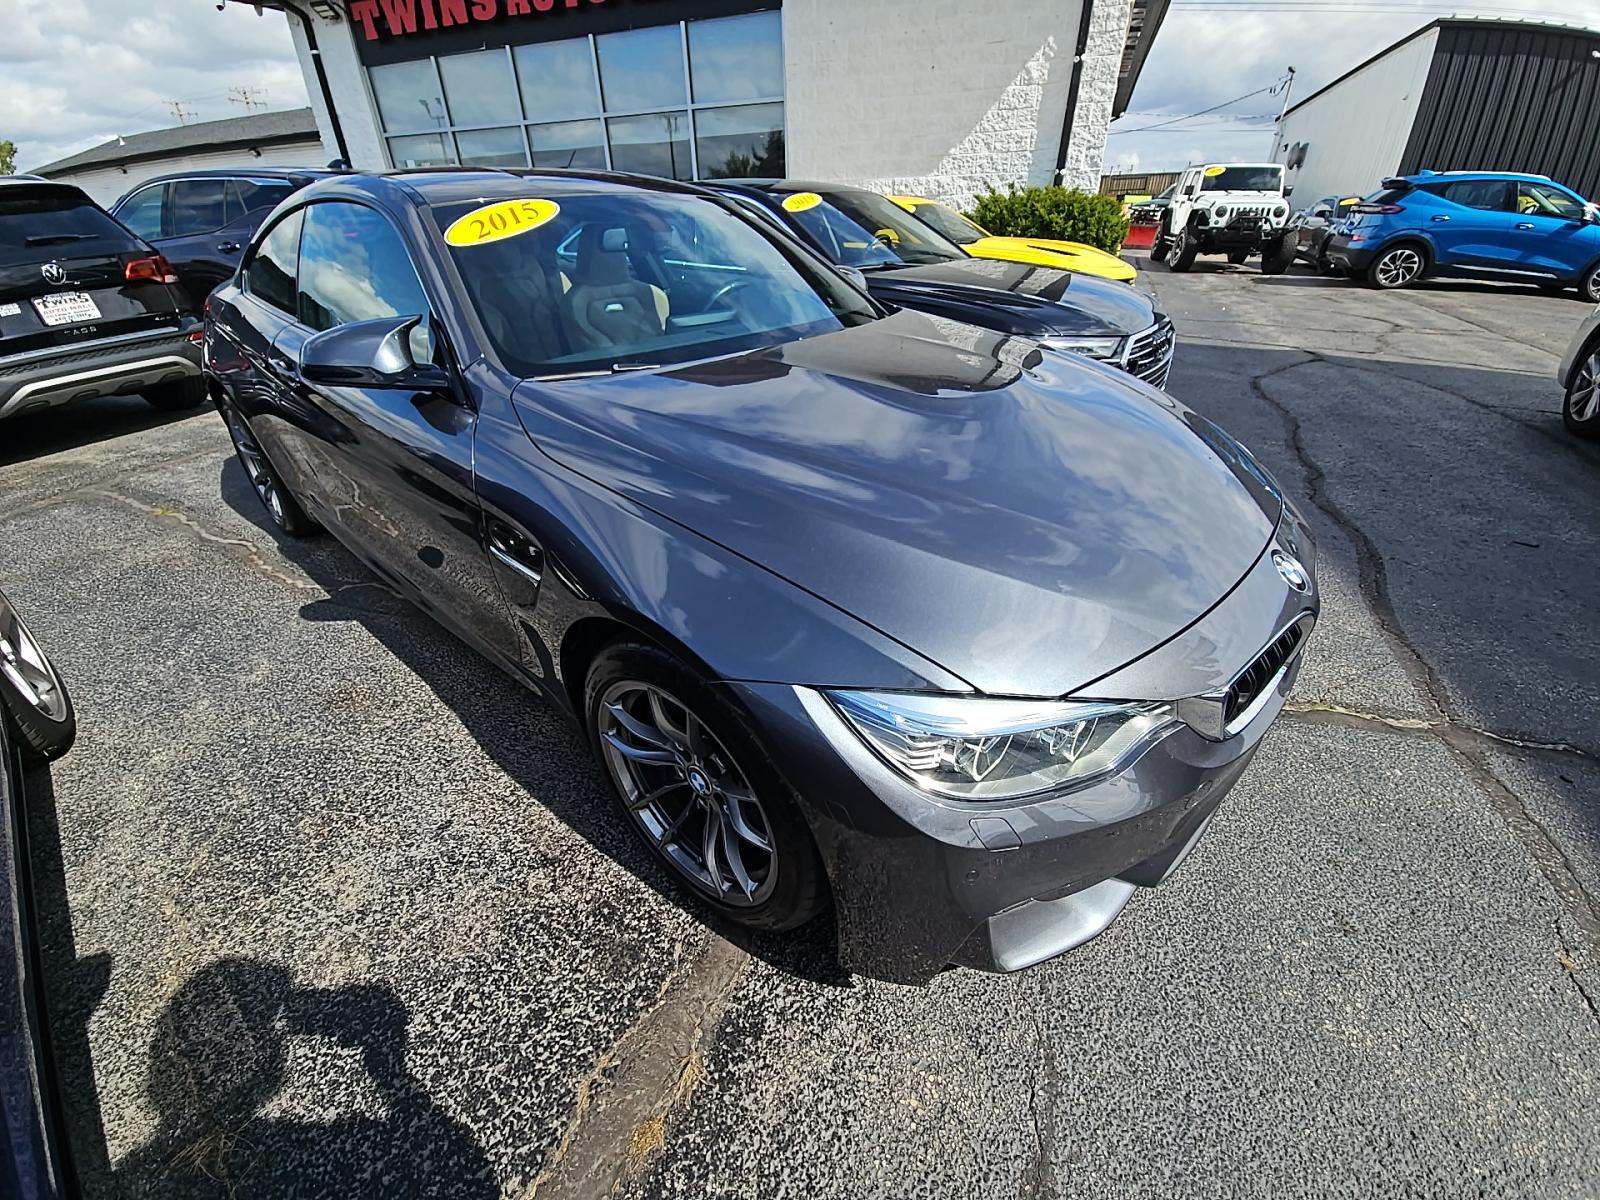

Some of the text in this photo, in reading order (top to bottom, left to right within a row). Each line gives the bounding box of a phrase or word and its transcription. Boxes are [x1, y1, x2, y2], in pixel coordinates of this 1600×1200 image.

[350, 0, 498, 40] TWINS
[469, 202, 539, 239] 2015
[37, 294, 89, 309] TWINS
